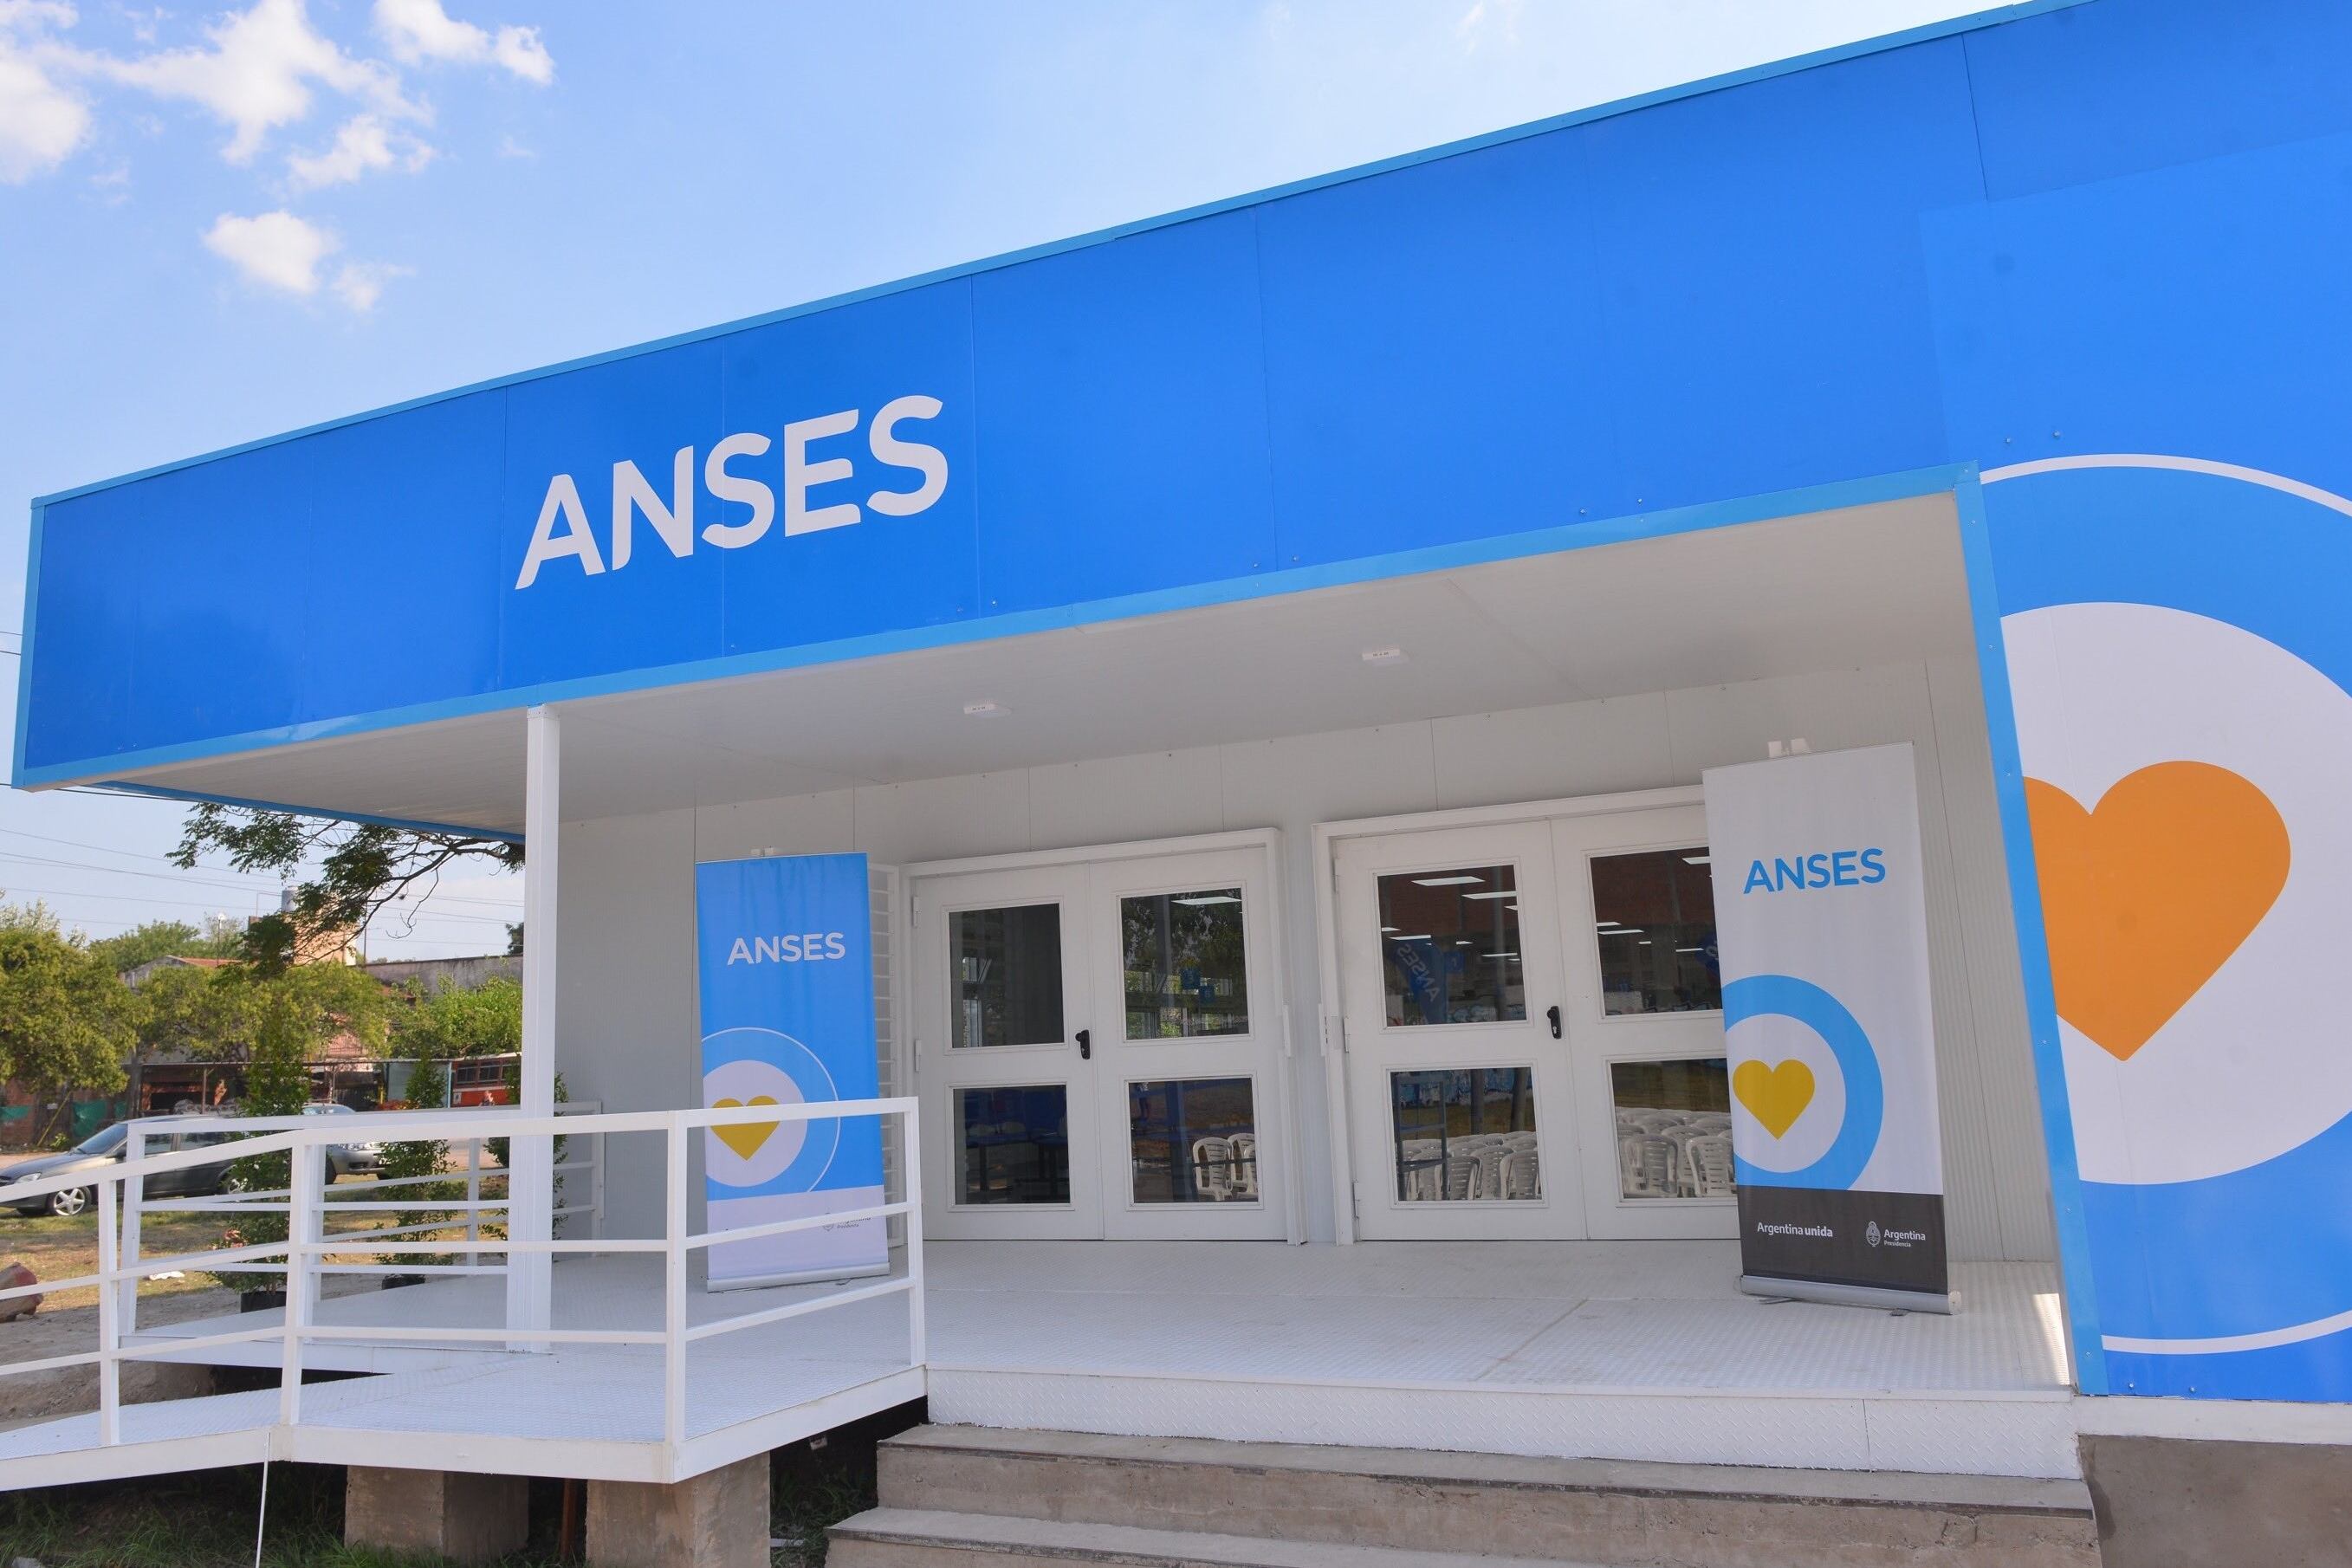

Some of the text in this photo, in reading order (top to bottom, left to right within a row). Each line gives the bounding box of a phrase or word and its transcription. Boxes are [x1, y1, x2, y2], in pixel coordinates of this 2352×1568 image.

[515, 395, 948, 590] ANSES
[1743, 848, 1886, 894] ANSES
[727, 932, 846, 966] ANSES
[1757, 1221, 1833, 1237] Argentina unida
[1883, 1229, 1926, 1241] Argentina
